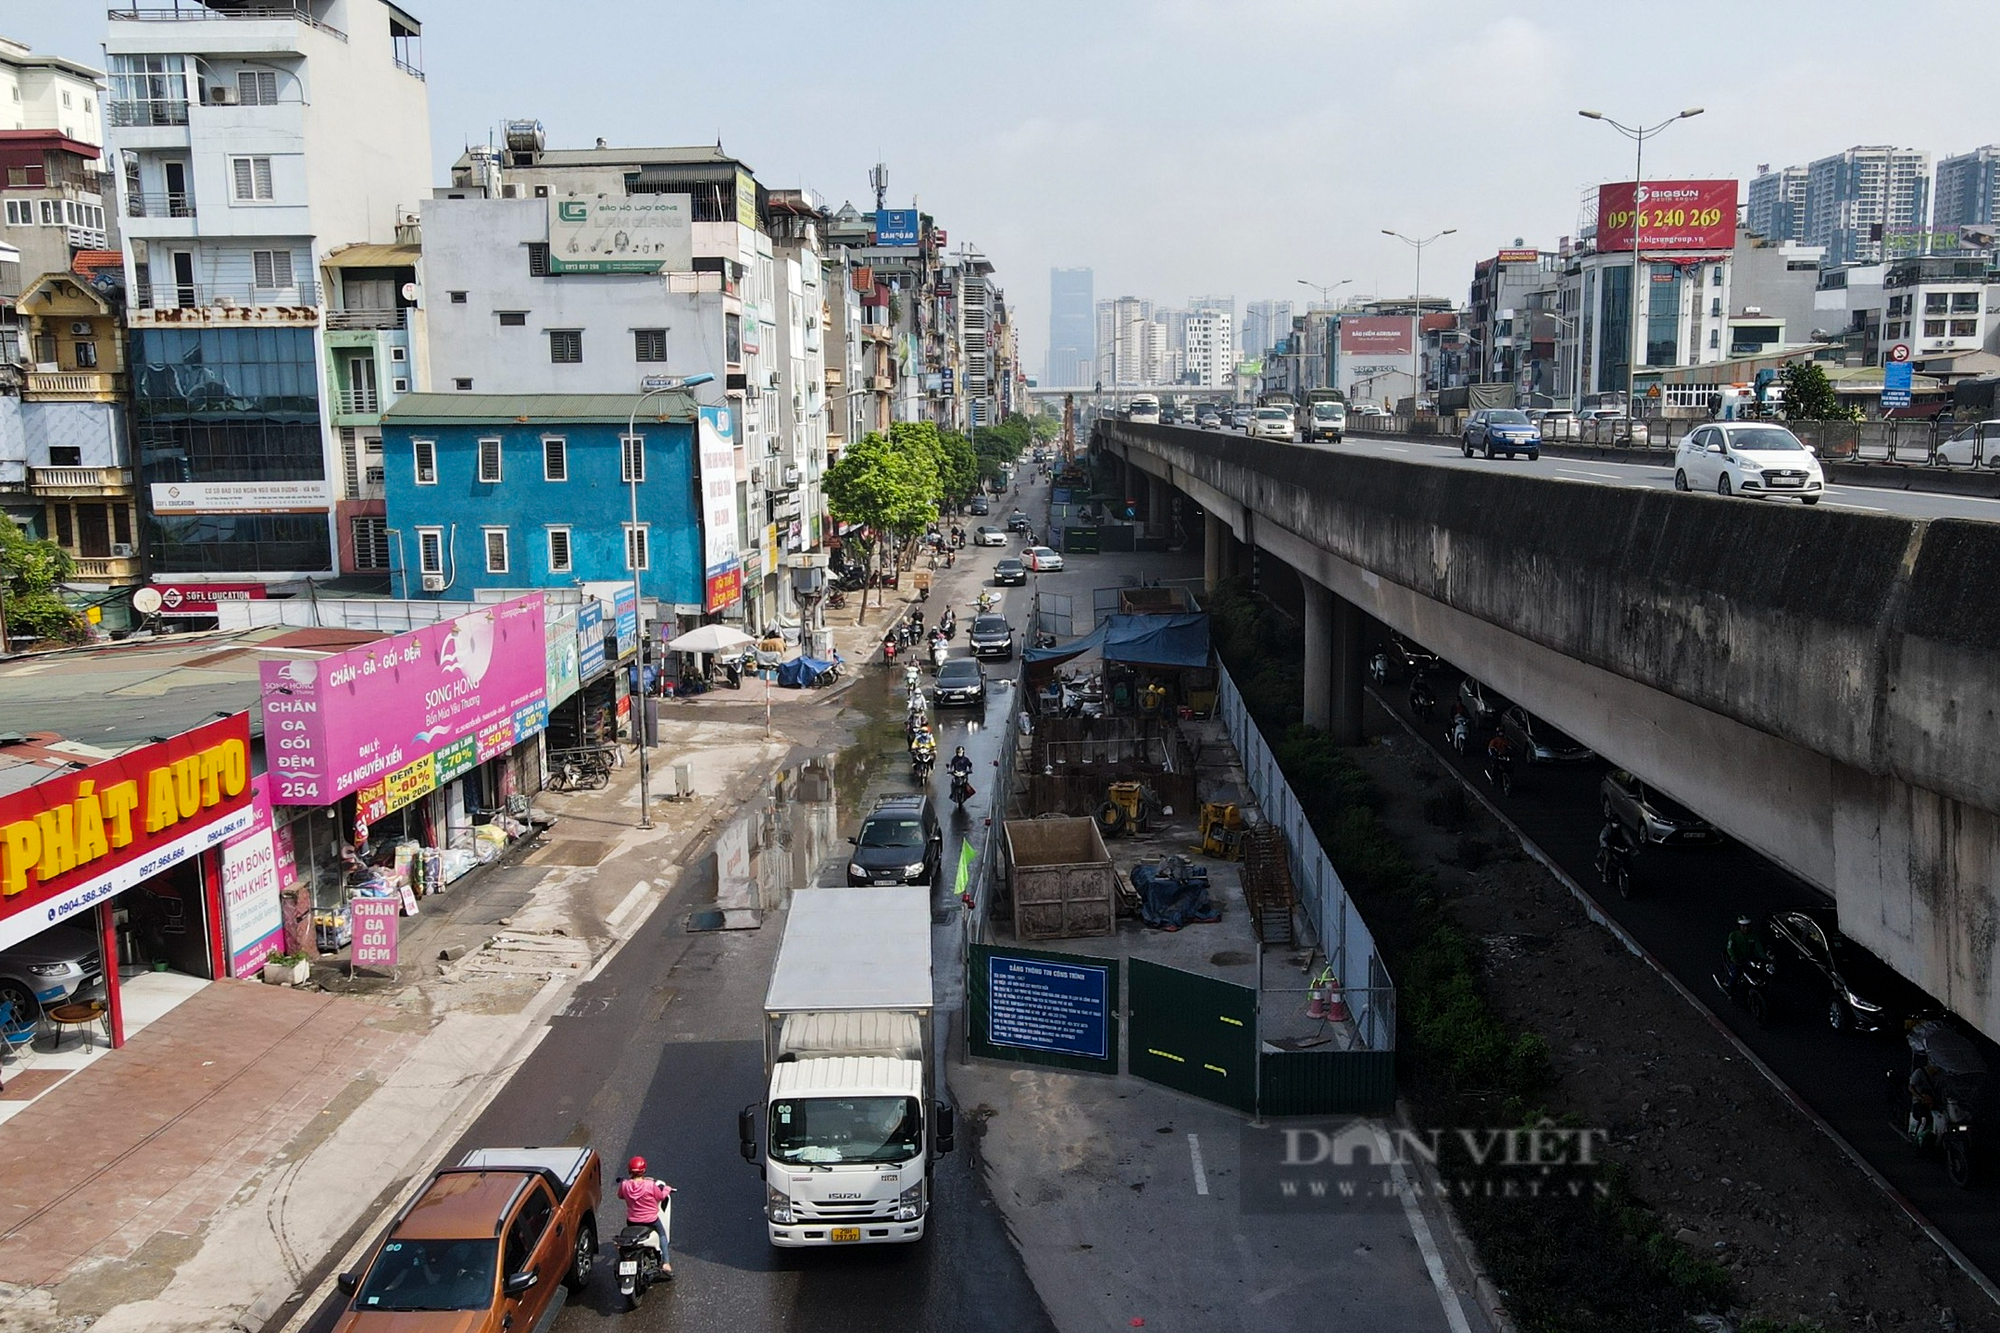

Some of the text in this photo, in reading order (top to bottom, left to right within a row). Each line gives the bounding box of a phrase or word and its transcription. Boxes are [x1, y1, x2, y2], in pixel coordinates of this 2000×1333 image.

[1651, 189, 1699, 198] BIGSUN
[1608, 207, 1721, 230] 0976 240 269
[186, 591, 250, 600] SOFL EDUCATION
[330, 664, 356, 688] CHĂN
[363, 659, 376, 676] GA
[383, 646, 399, 669] GỐI
[425, 685, 452, 710] SONG
[267, 699, 317, 713] CHĂN
[281, 720, 307, 731] GA
[280, 734, 310, 749] GỐI
[484, 727, 512, 746] -50%
[277, 755, 315, 770] ĐỆM
[416, 757, 429, 771] SV
[443, 748, 472, 768] -70%
[337, 773, 354, 792] 254
[353, 753, 386, 784] NGUYỄN
[385, 743, 403, 768] XIỂN
[396, 769, 430, 793] -60%
[281, 782, 319, 798] 254
[0, 738, 246, 897] PHÁT AUTO
[246, 846, 272, 872] BÔNG
[249, 864, 273, 896] KHIẾT
[283, 872, 294, 887] GA
[58, 881, 113, 917] 0904.388.368
[354, 903, 395, 916] CHĂN
[365, 919, 385, 930] GA
[362, 930, 387, 946] GỐI
[358, 946, 390, 962] ĐỆM
